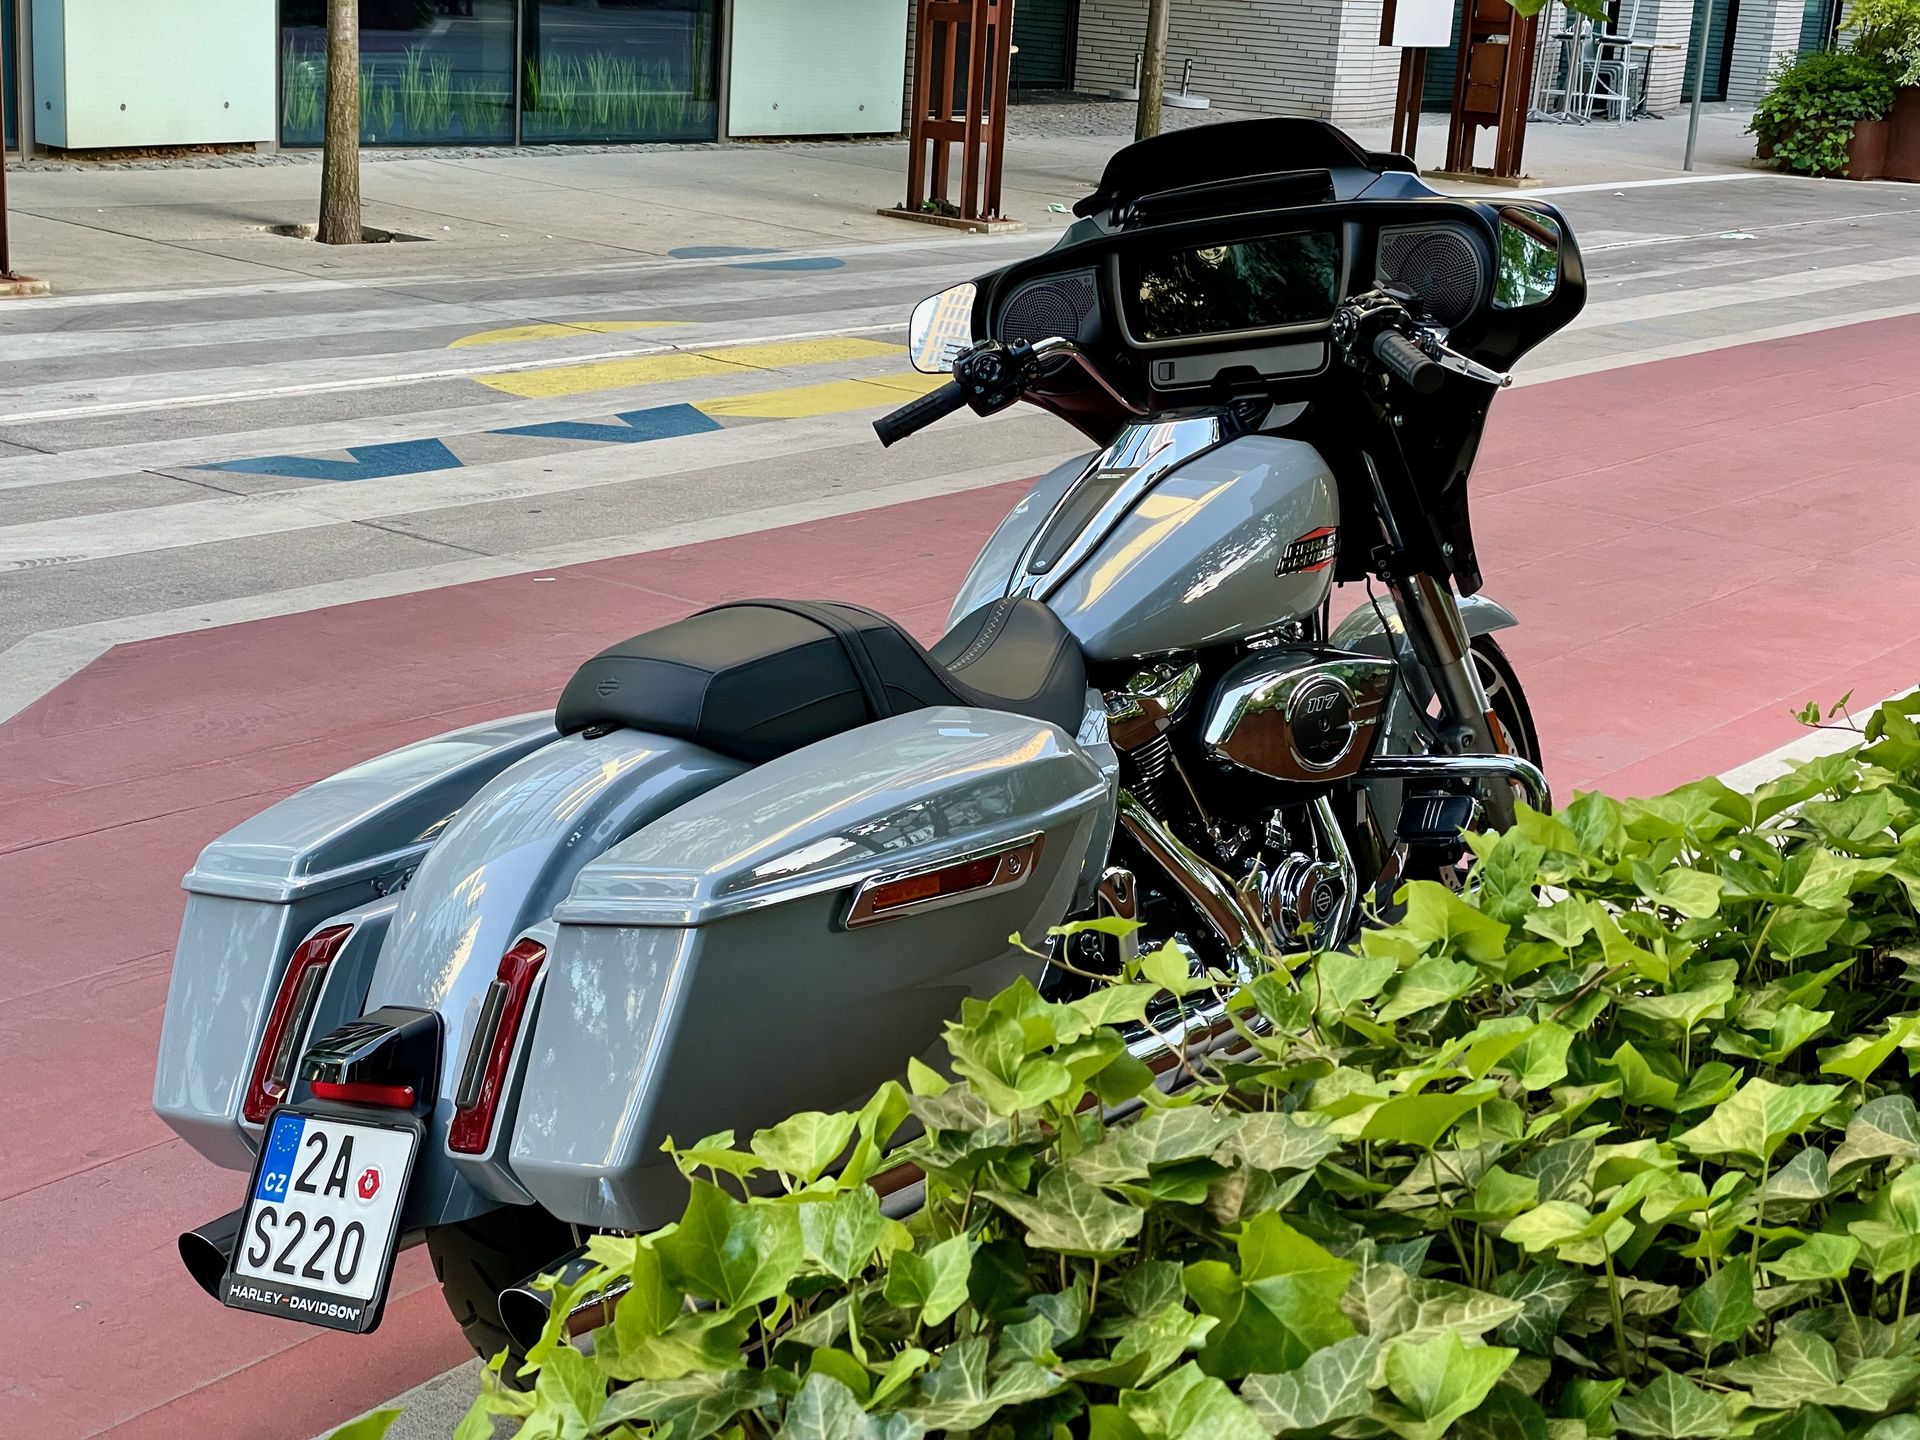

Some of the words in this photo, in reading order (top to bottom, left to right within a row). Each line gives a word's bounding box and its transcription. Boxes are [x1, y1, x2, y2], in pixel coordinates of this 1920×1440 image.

[1307, 692, 1339, 713] 117
[264, 1171, 287, 1193] CZ
[294, 1131, 355, 1198] 2A
[248, 1206, 365, 1285] S220
